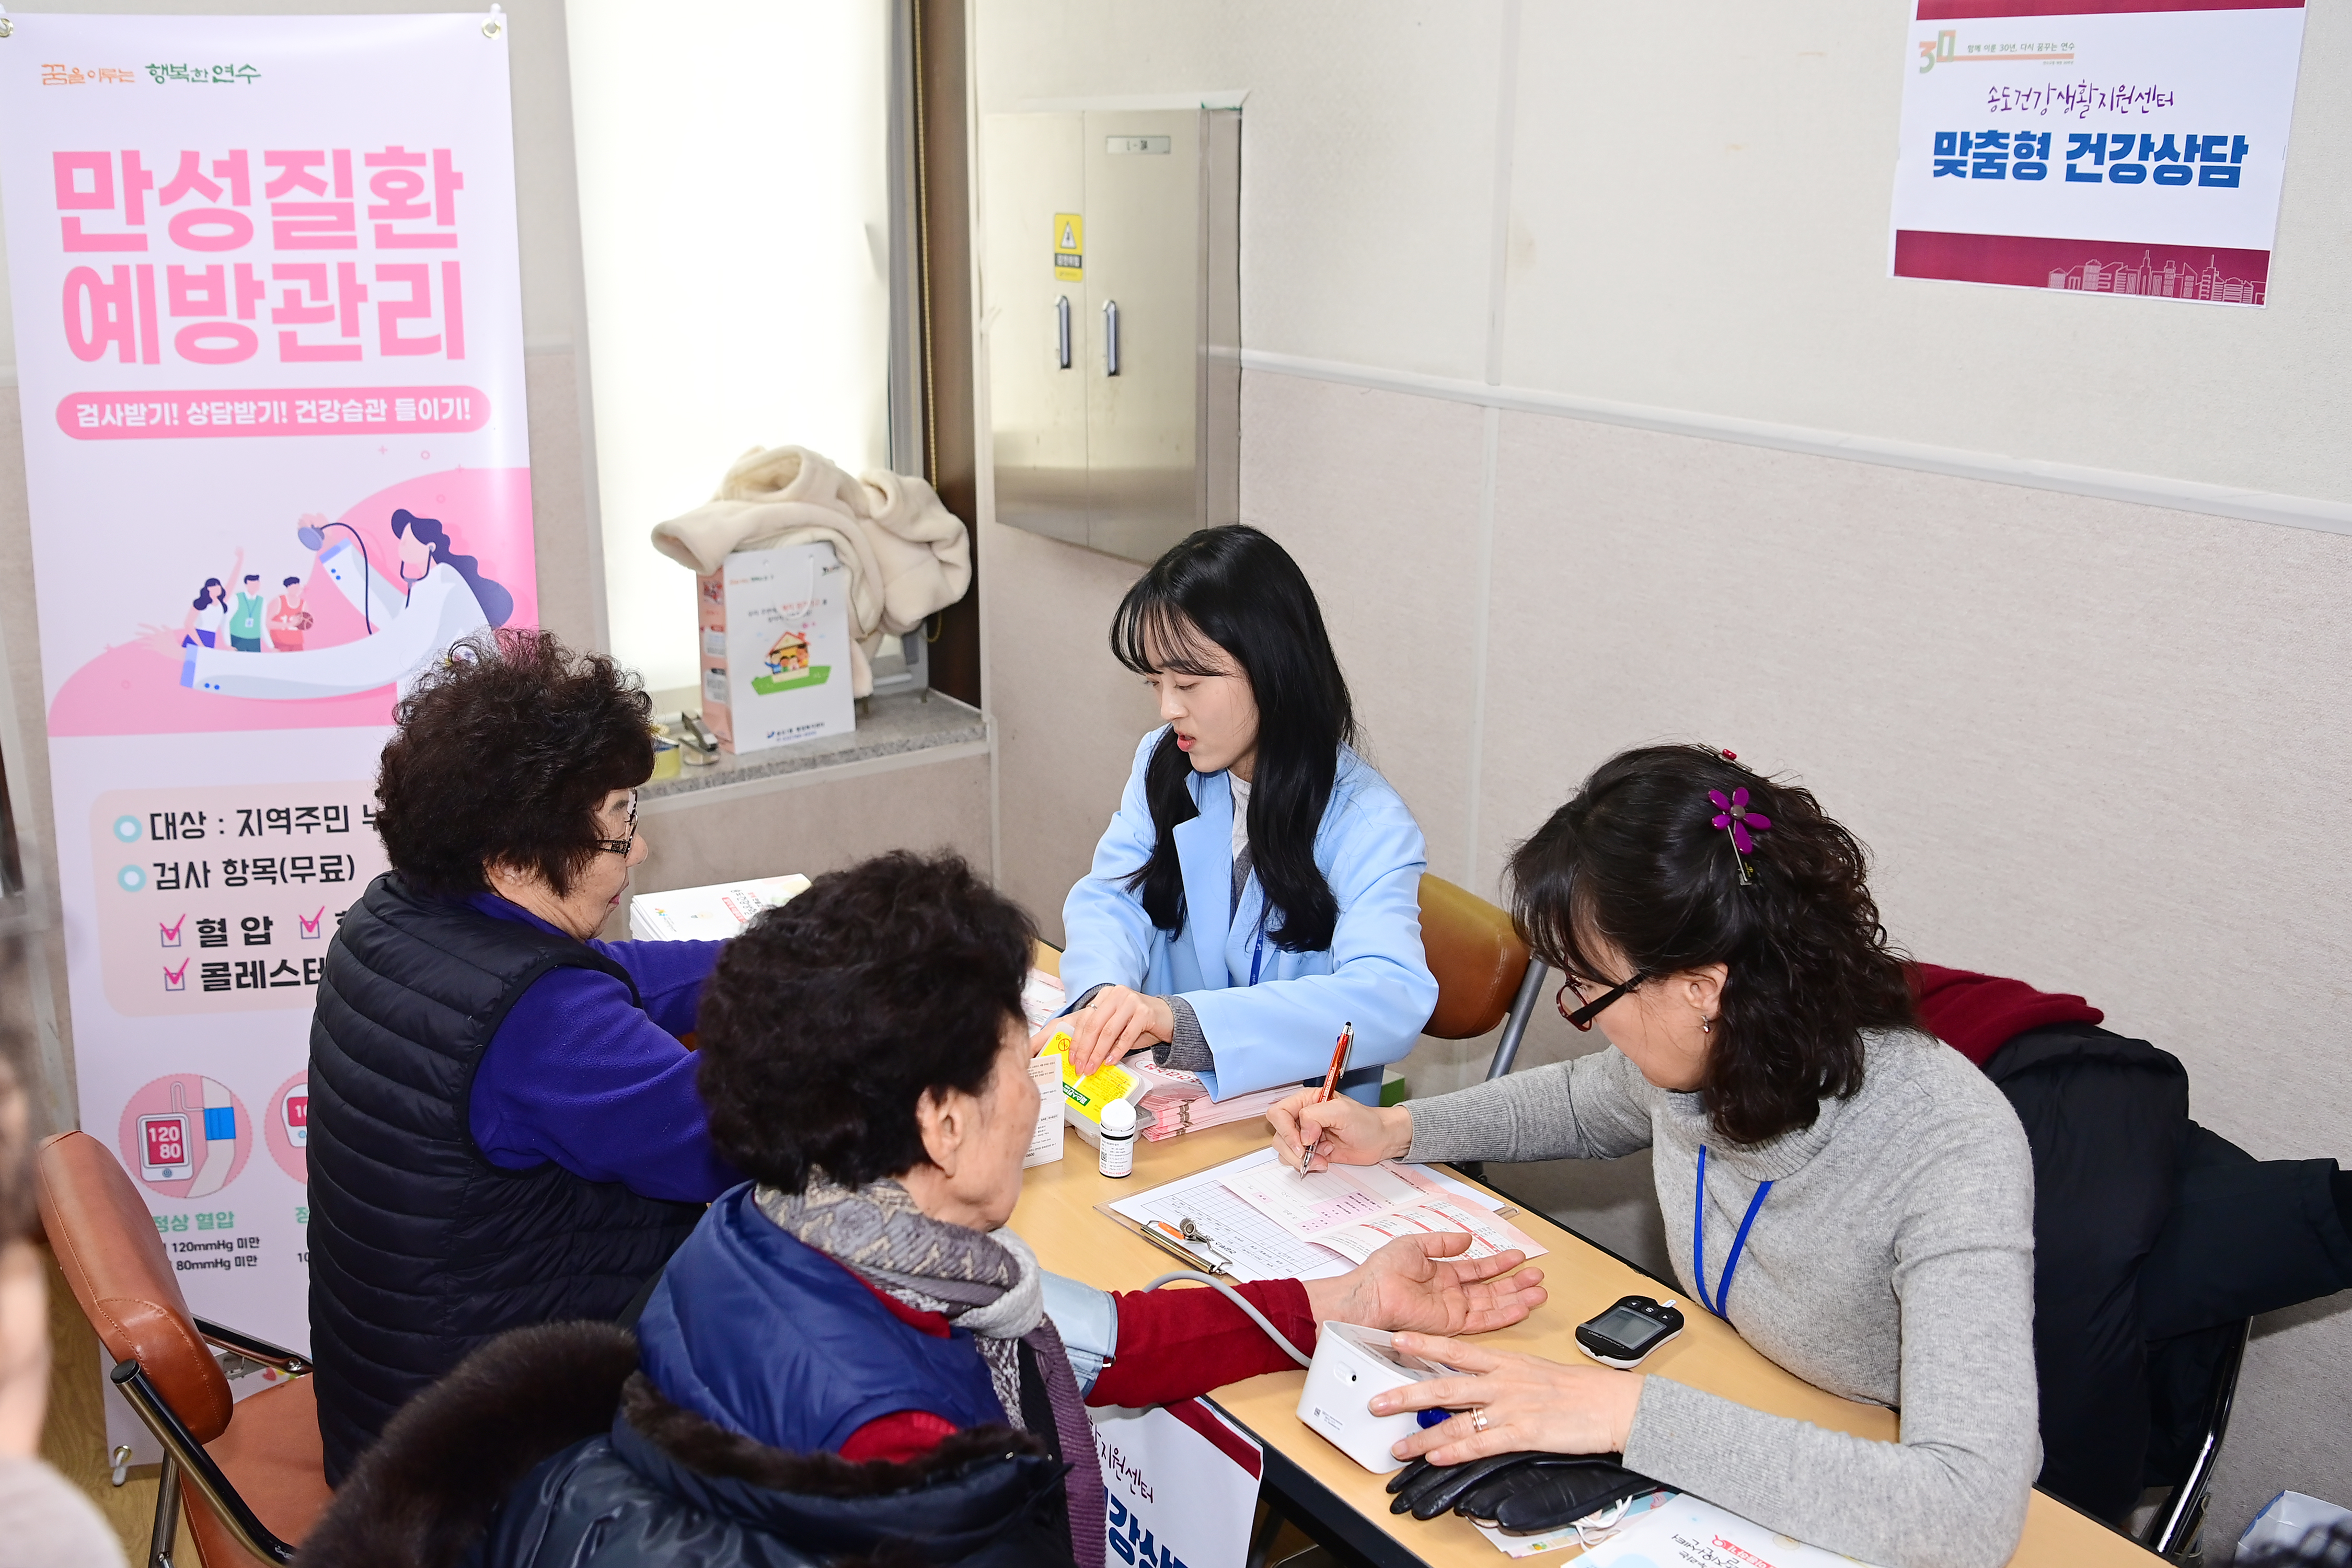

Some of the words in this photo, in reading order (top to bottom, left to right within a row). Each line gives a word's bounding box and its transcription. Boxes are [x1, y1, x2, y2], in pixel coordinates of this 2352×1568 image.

[2020, 43, 2034, 51] 다시
[2037, 43, 2058, 51] 꿈꾸는
[2061, 42, 2075, 51] 연수
[1987, 78, 2174, 118] 송도건강생활지원센터
[1932, 130, 2052, 181] 맞춤형
[2065, 133, 2249, 188] 건강상담
[52, 145, 464, 252] 만성질환
[62, 260, 465, 365] 예방관리
[76, 402, 179, 428] 검사받기!
[186, 400, 287, 424] 상담받기!
[294, 399, 387, 423] 건강습관
[395, 397, 470, 421] 들이기!
[149, 811, 206, 842] 대상
[236, 804, 349, 837] 지역주민
[153, 860, 210, 891] 검사
[222, 854, 356, 887] 항목(무료)
[201, 958, 326, 992] 콜레스테
[149, 1126, 180, 1143] 120
[159, 1143, 180, 1159] 80
[195, 1211, 235, 1230] 혈압
[172, 1240, 234, 1252] 120mmHg
[237, 1237, 260, 1249] 미만
[176, 1258, 231, 1271] 80mmHg
[235, 1255, 257, 1267] 미만
